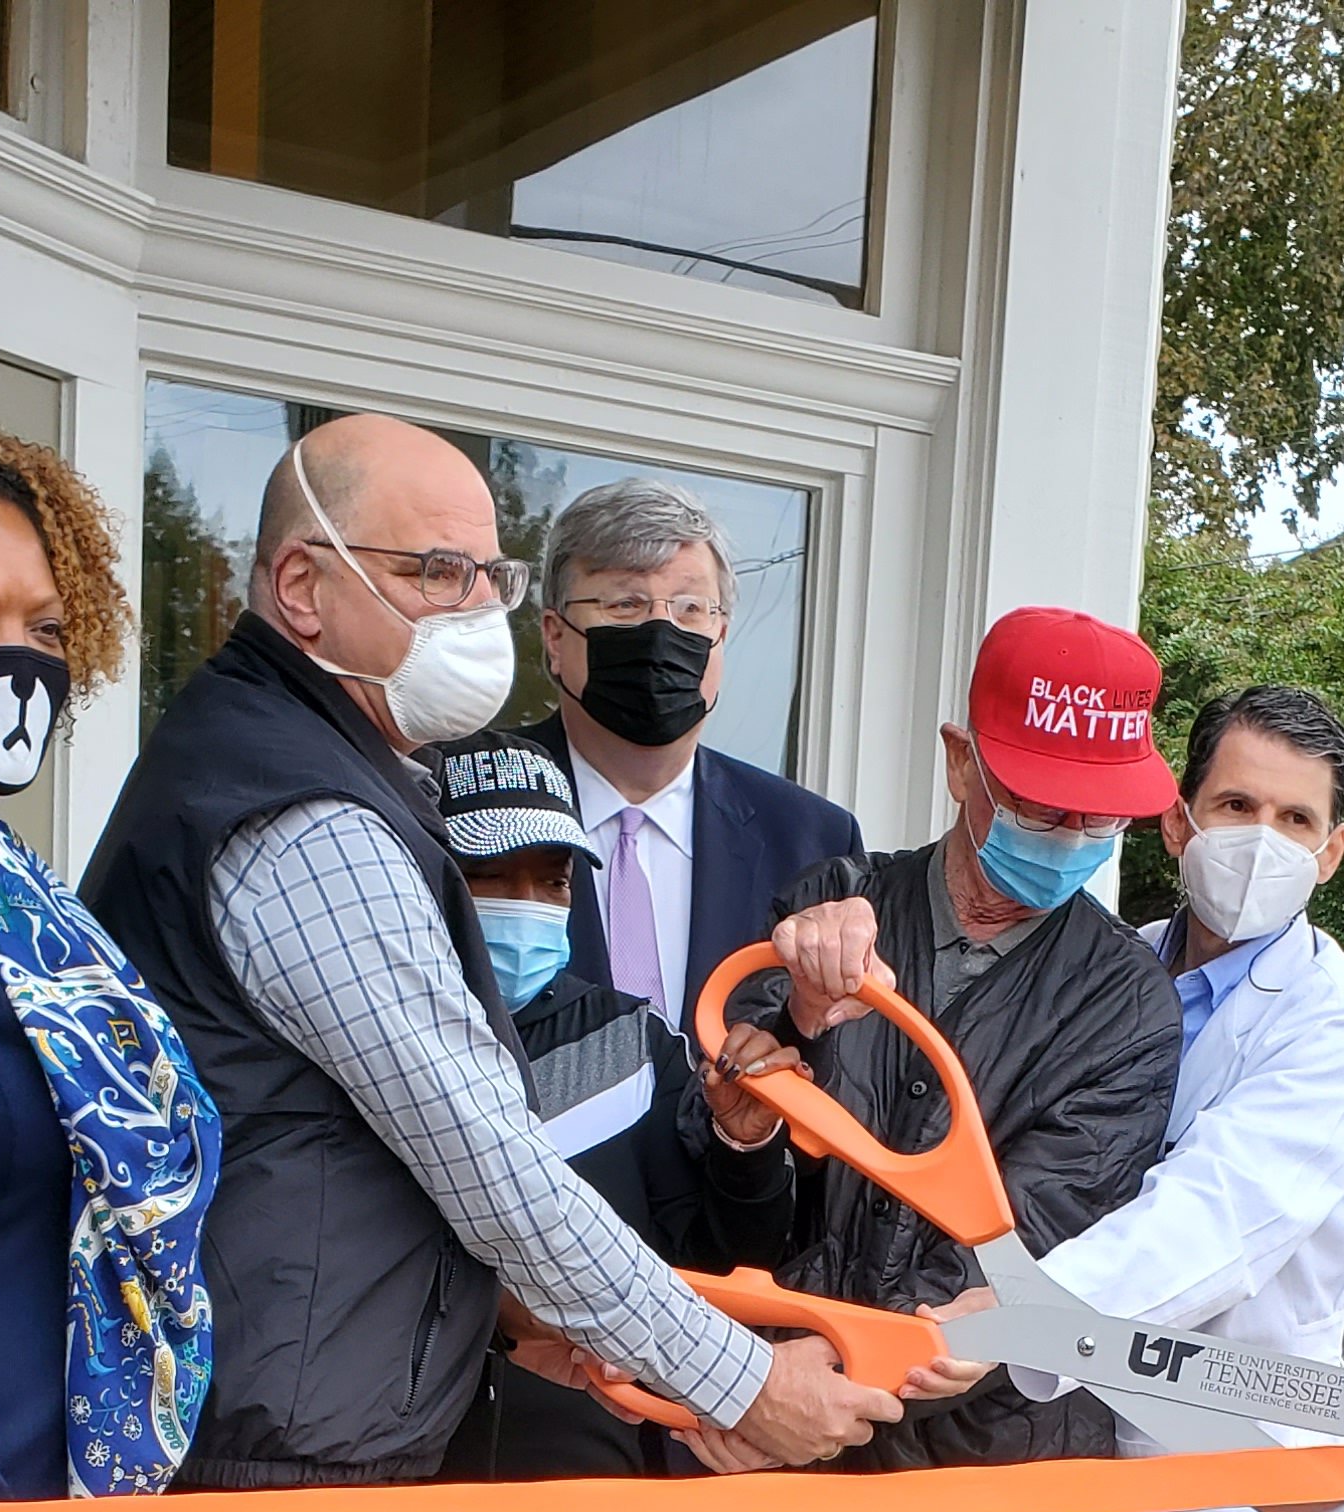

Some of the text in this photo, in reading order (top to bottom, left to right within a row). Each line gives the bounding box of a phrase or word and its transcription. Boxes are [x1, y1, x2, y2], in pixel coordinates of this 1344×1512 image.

[1030, 676, 1152, 710] BLACK LIVES
[1024, 697, 1149, 741] MATTER
[445, 747, 573, 809] MEMPHI
[1128, 1331, 1206, 1383] UT
[1207, 1347, 1236, 1363] THE
[1239, 1354, 1324, 1382] UNIVERSITY
[1199, 1380, 1243, 1400] HEALTH
[1244, 1391, 1292, 1410] SCIENCE
[1202, 1359, 1343, 1409] TENNESSEE
